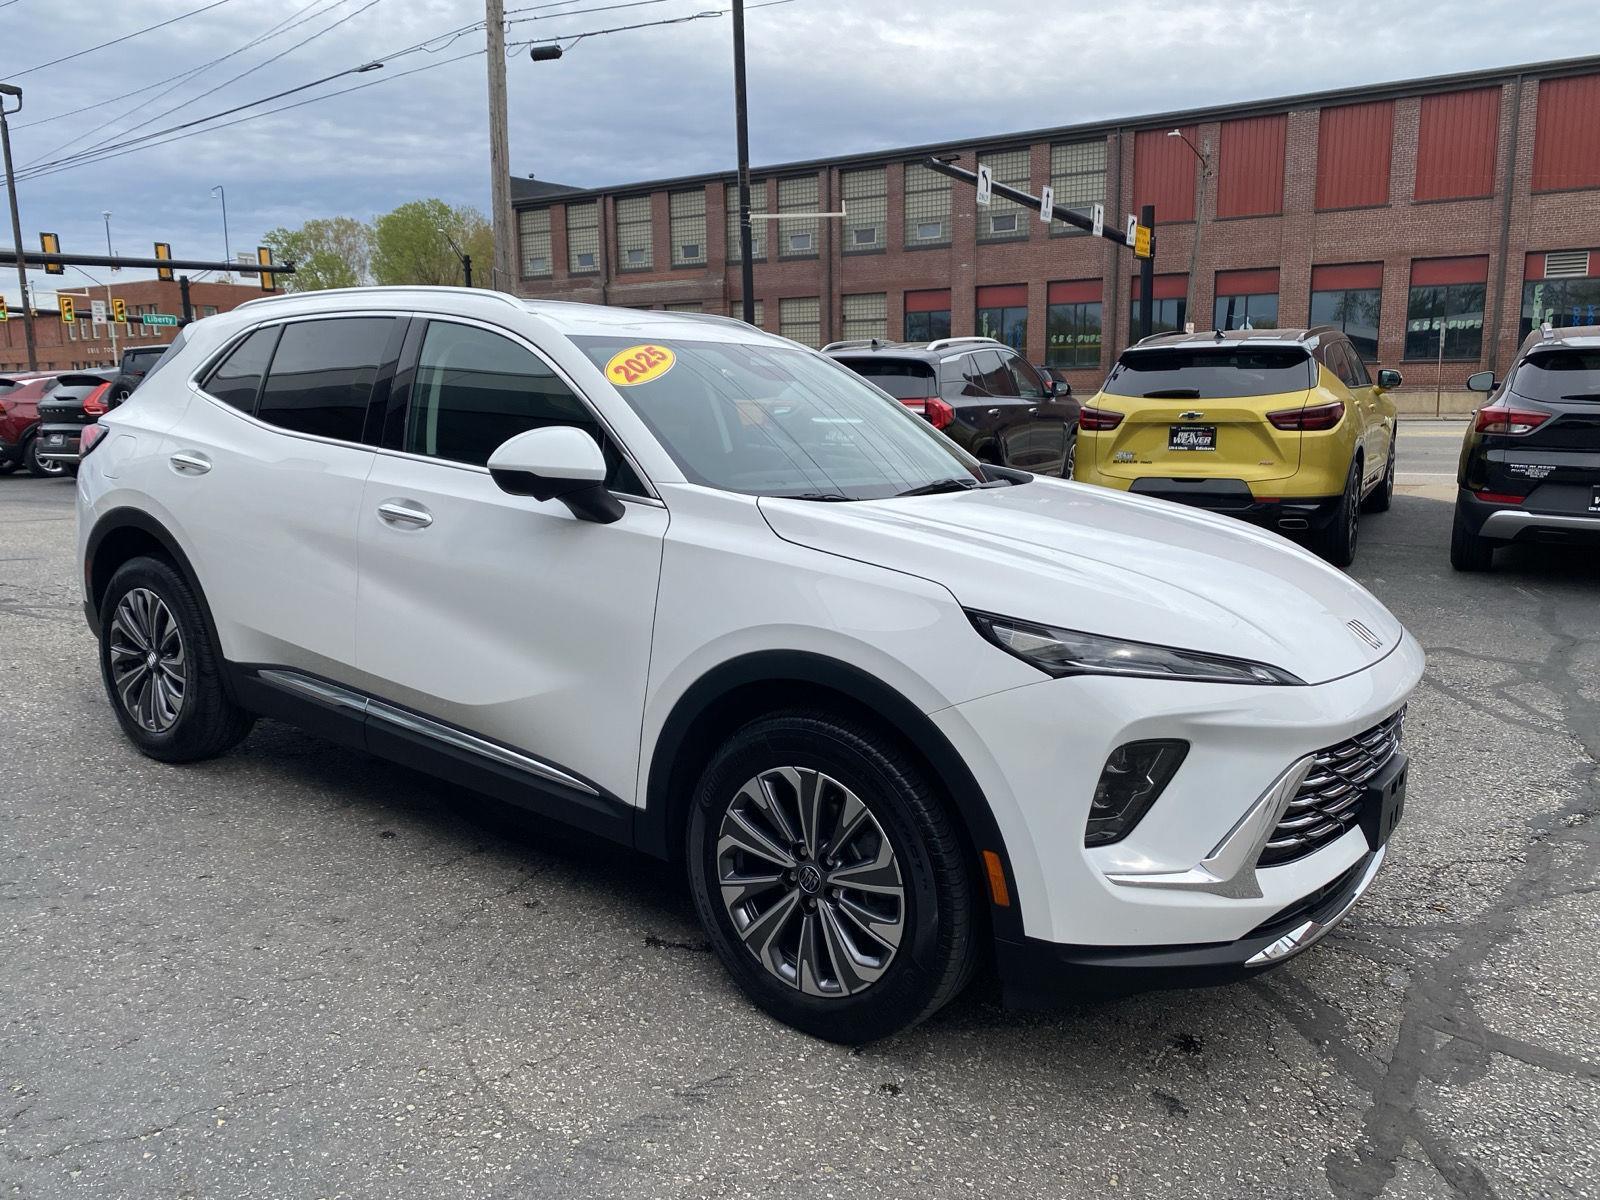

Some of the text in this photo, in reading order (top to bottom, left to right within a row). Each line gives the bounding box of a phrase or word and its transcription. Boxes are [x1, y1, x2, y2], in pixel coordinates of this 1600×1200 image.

[147, 315, 173, 325] Liberty
[613, 346, 667, 383] 2025
[1173, 436, 1212, 444] WEAVER
